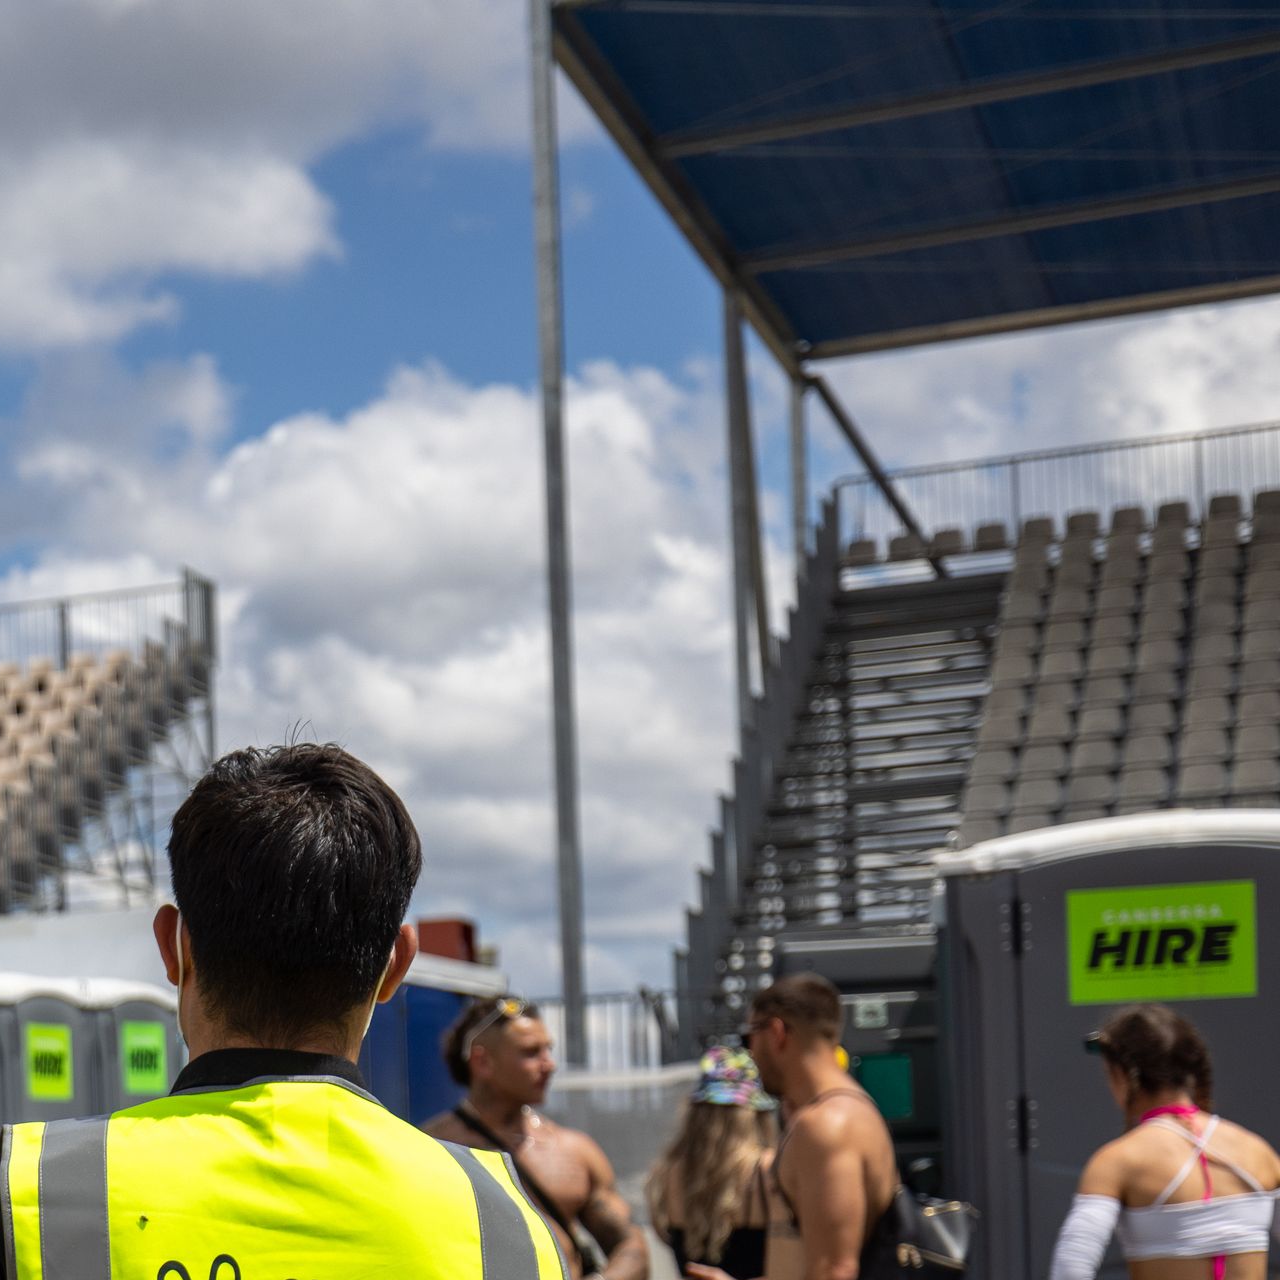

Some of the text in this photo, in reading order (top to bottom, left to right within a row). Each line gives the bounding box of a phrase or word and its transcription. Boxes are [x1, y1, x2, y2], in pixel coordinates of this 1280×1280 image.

[1088, 923, 1237, 970] HIRE
[33, 1052, 66, 1079] HIRE
[129, 1049, 160, 1073] HIRE
